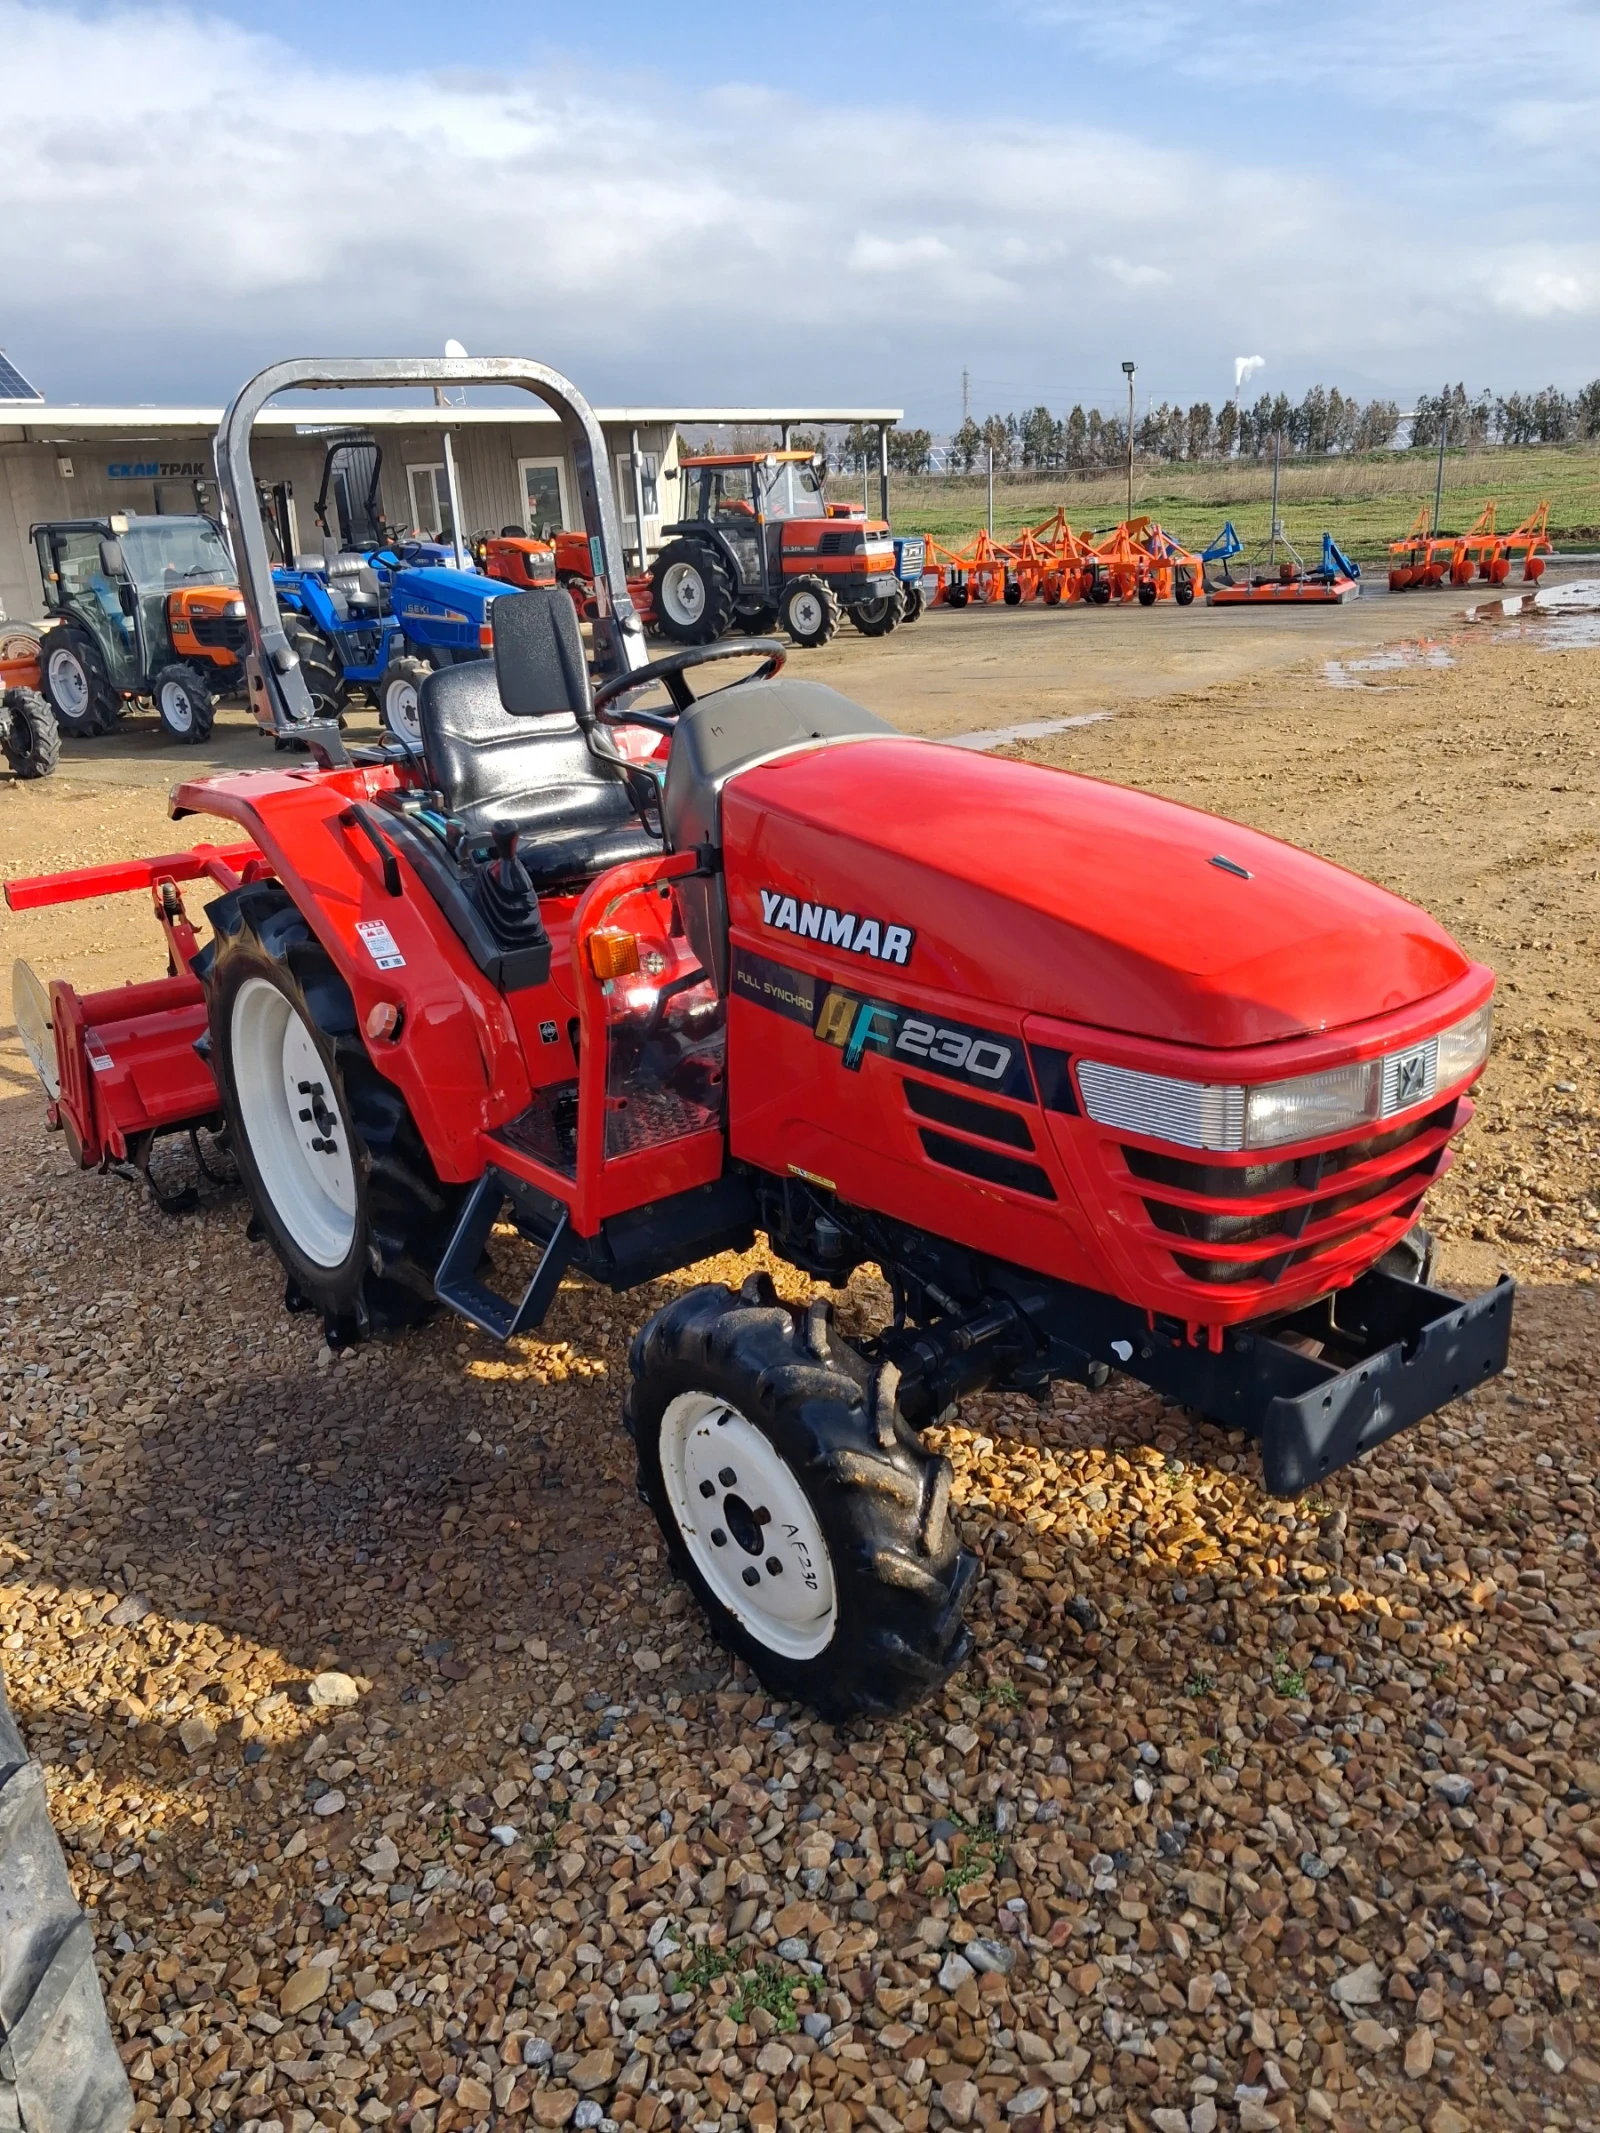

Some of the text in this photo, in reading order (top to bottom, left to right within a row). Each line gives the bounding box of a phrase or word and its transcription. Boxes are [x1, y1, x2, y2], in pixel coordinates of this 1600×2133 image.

[405, 604, 430, 614] ISEKI
[760, 889, 912, 964] YANMAR
[737, 970, 761, 990] FULL
[764, 981, 814, 1012] SYNCHRO
[781, 1524, 818, 1591] AF230
